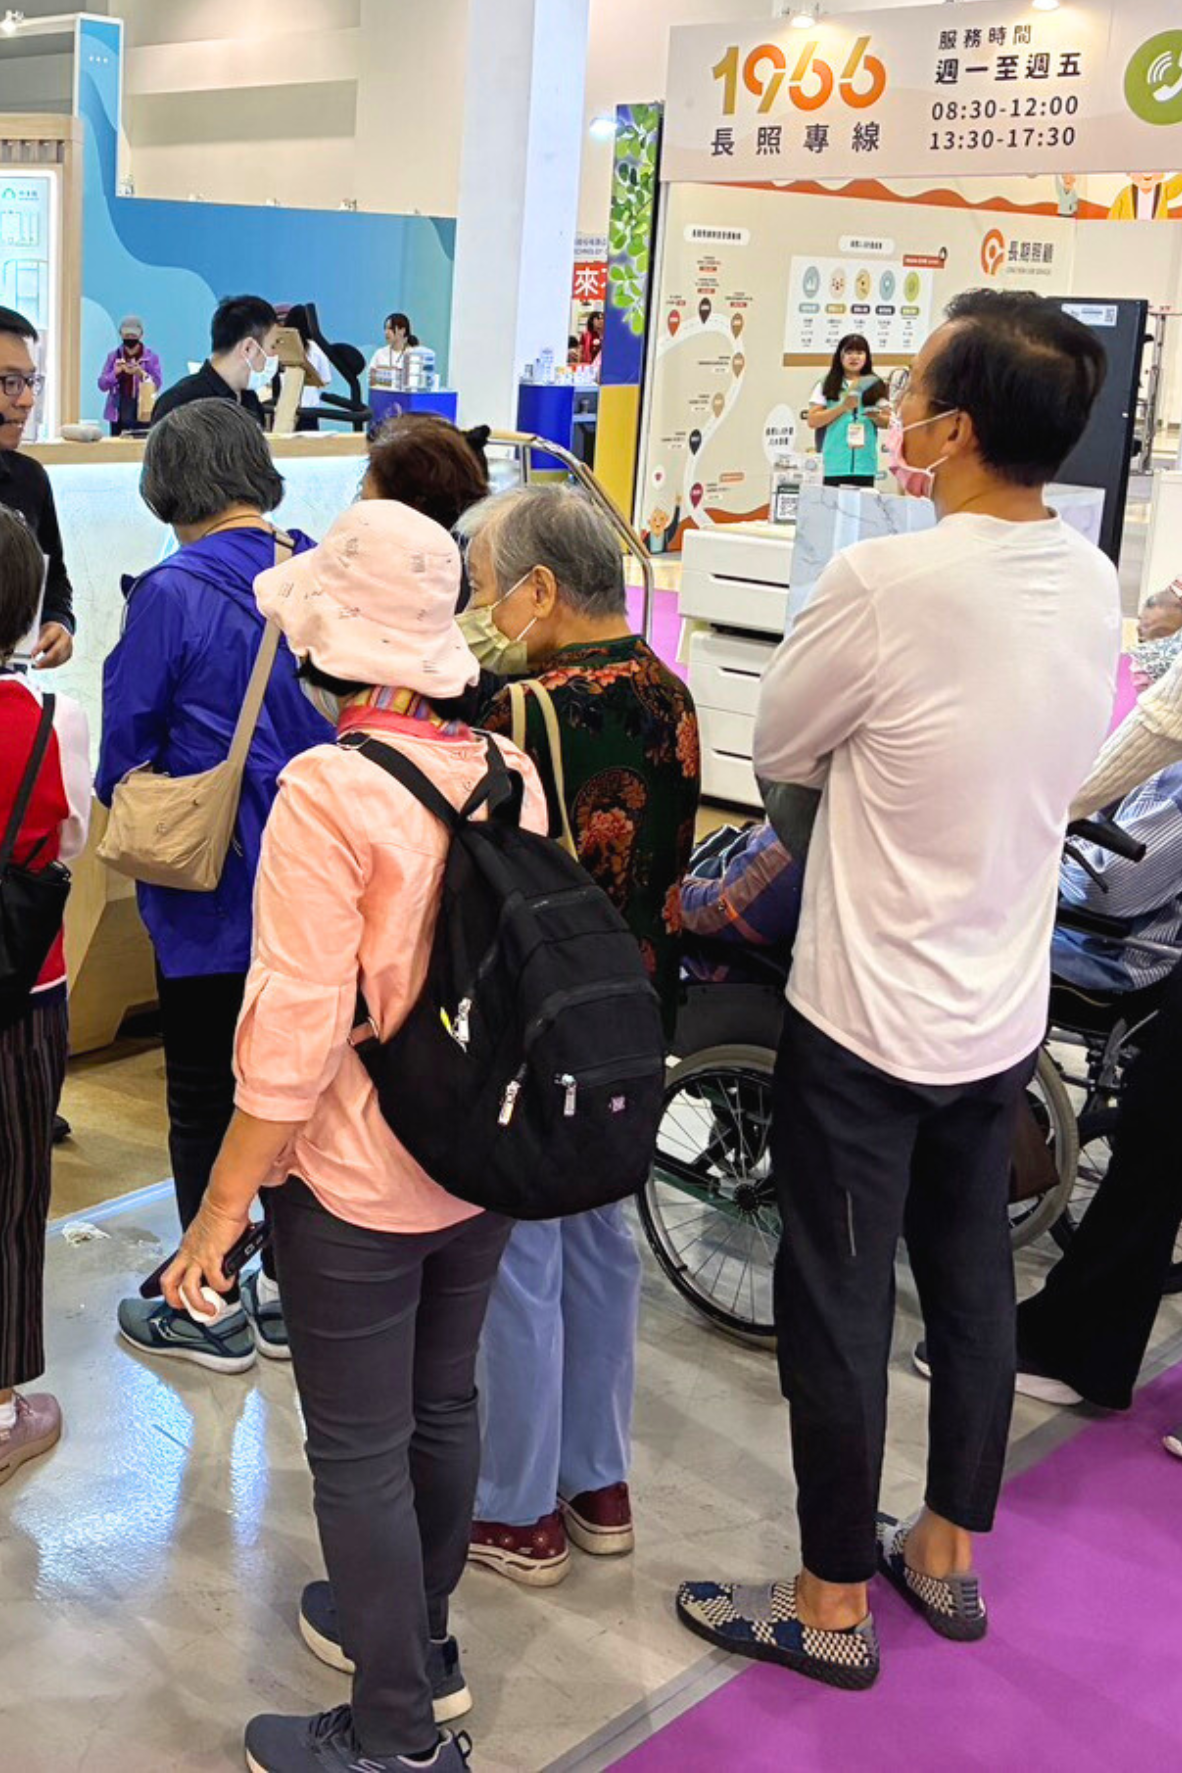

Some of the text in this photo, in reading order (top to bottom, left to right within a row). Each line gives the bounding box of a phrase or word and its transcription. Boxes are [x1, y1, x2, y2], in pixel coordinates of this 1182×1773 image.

[938, 25, 1032, 50] 服務時間
[711, 36, 886, 115] 1966
[935, 52, 1082, 85] 週一至週五
[931, 95, 1079, 120] 08:30-12:00
[710, 121, 881, 157] 長照專線
[929, 126, 1076, 151] 13:30-17:30
